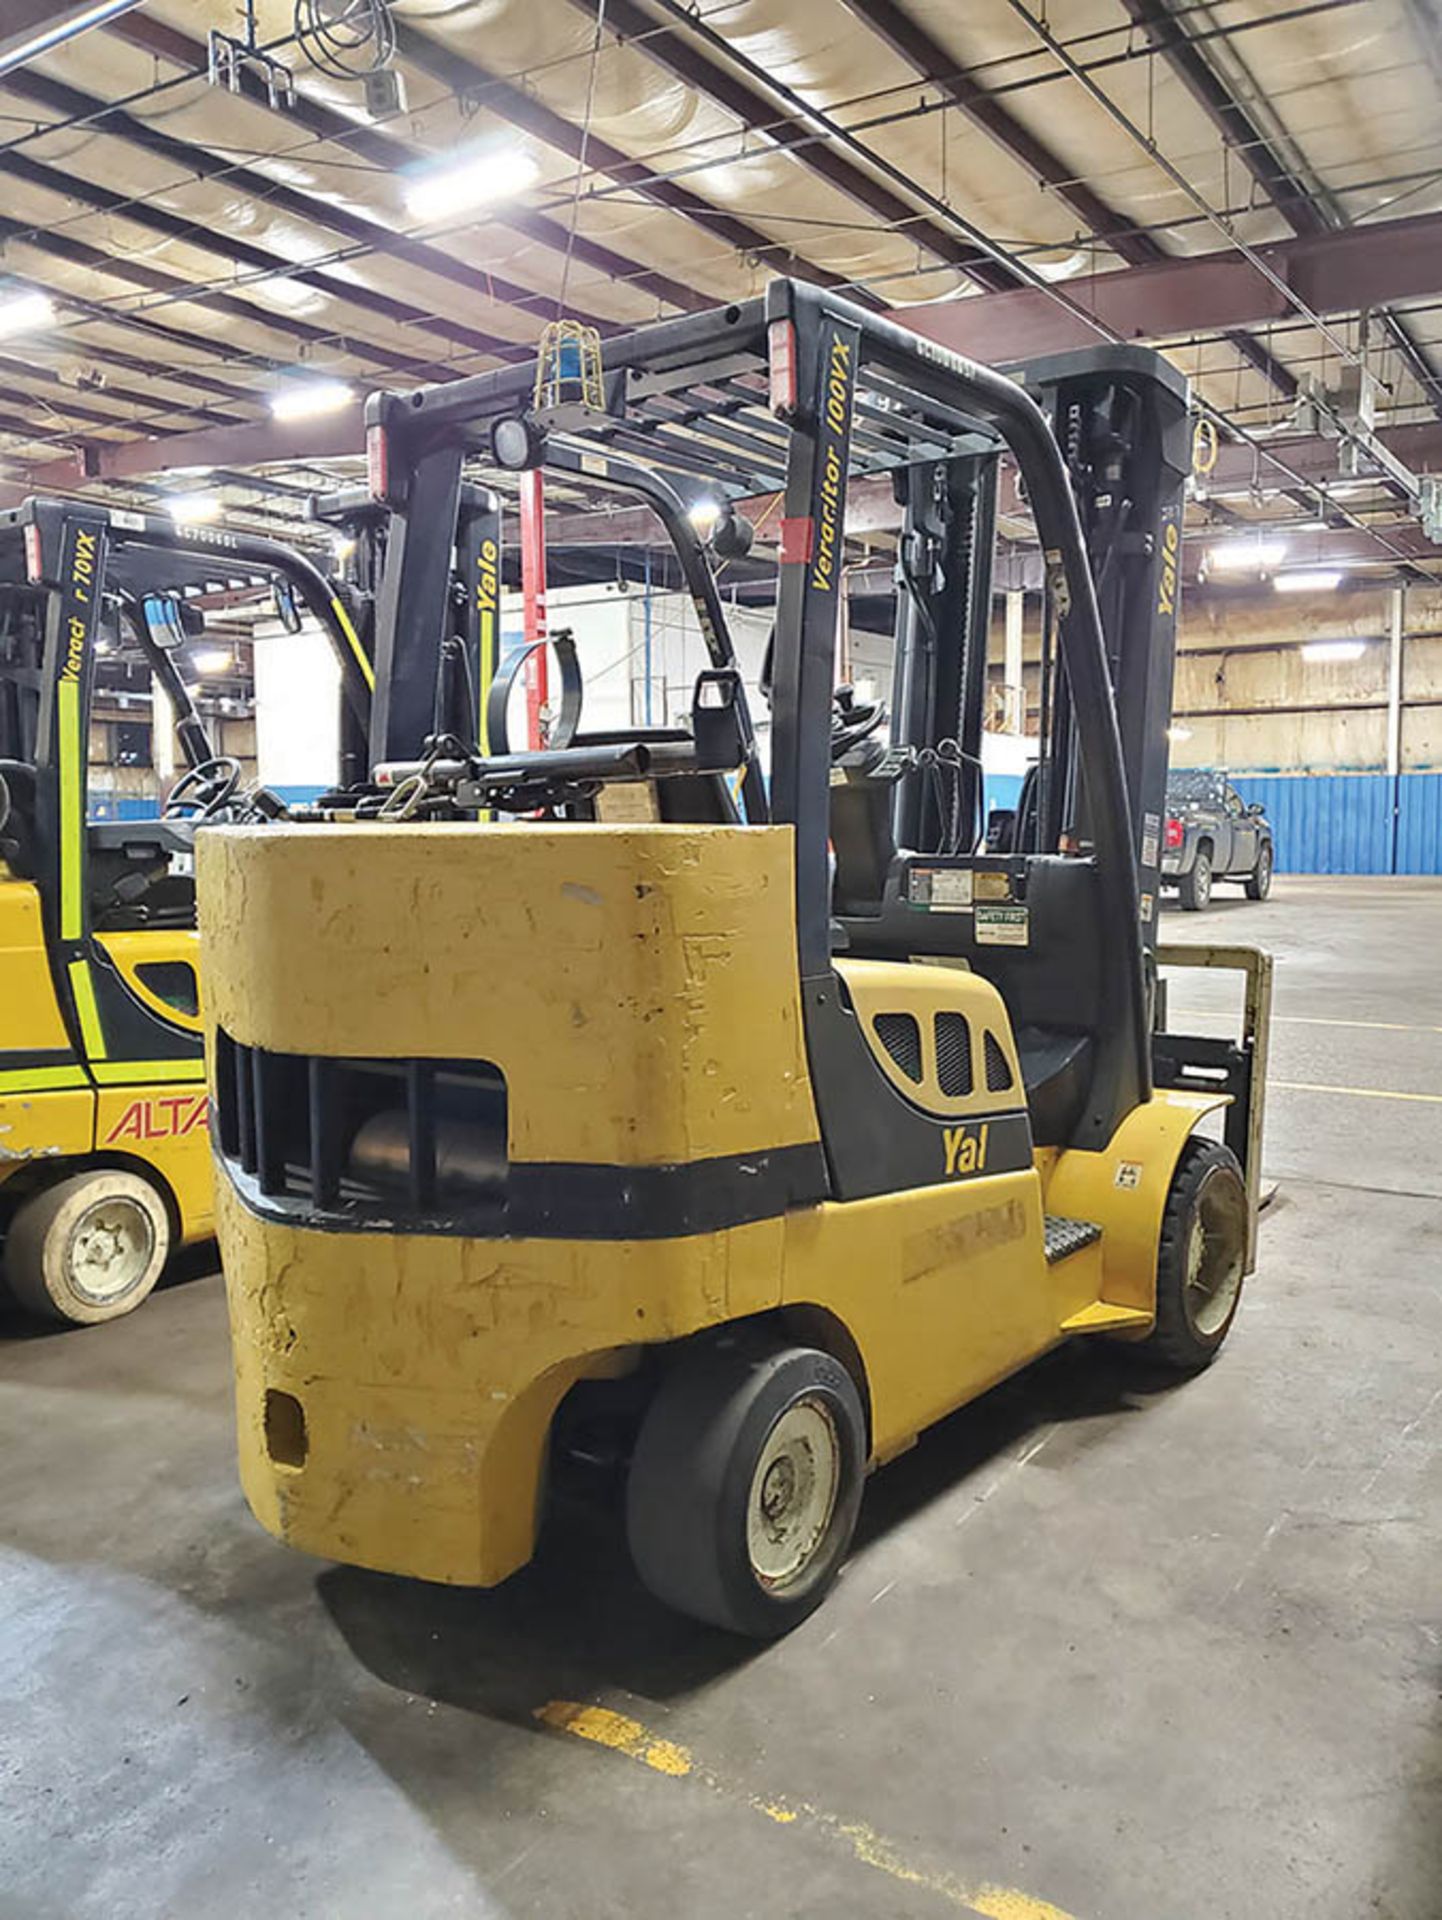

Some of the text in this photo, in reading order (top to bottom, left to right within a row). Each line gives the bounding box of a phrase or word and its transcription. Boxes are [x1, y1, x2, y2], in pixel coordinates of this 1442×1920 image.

[813, 332, 850, 592] Veracitor 100VX
[72, 529, 97, 586] 70VX
[477, 540, 497, 610] Yale
[1158, 523, 1178, 615] Yale
[106, 1095, 210, 1144] ALTA
[943, 1124, 990, 1175] Yal
